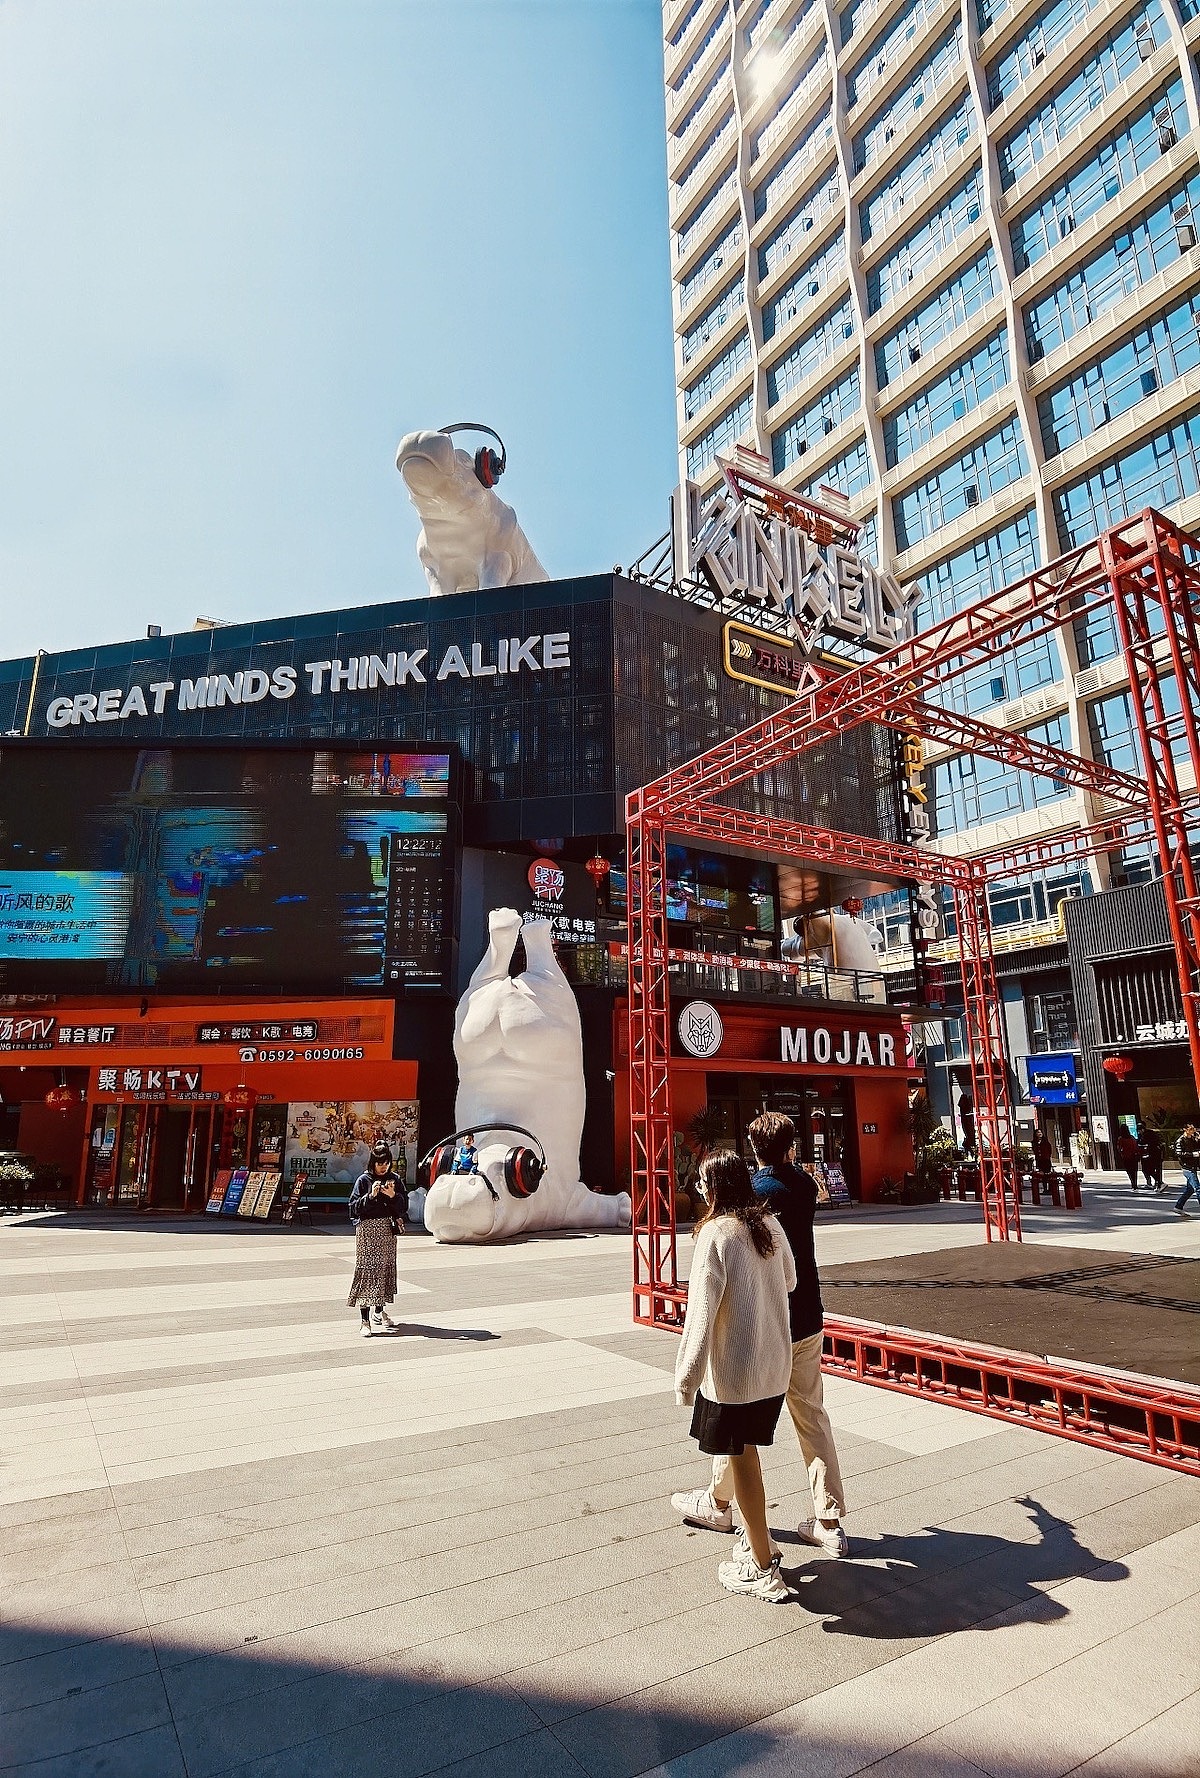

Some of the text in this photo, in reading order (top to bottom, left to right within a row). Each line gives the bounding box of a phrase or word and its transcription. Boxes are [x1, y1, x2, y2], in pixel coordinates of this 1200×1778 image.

[46, 632, 571, 728] GREAT MINDS THINK ALIKE
[0, 893, 75, 913] 听风的歌
[532, 900, 564, 911] JUCHANG
[572, 918, 595, 933] 电竞
[58, 1027, 115, 1043] 聚会餐厅
[262, 1026, 281, 1038] K歌
[292, 1025, 314, 1038] 电竞
[780, 1026, 896, 1066] MOJAR
[259, 1047, 363, 1062] 0592-6090165
